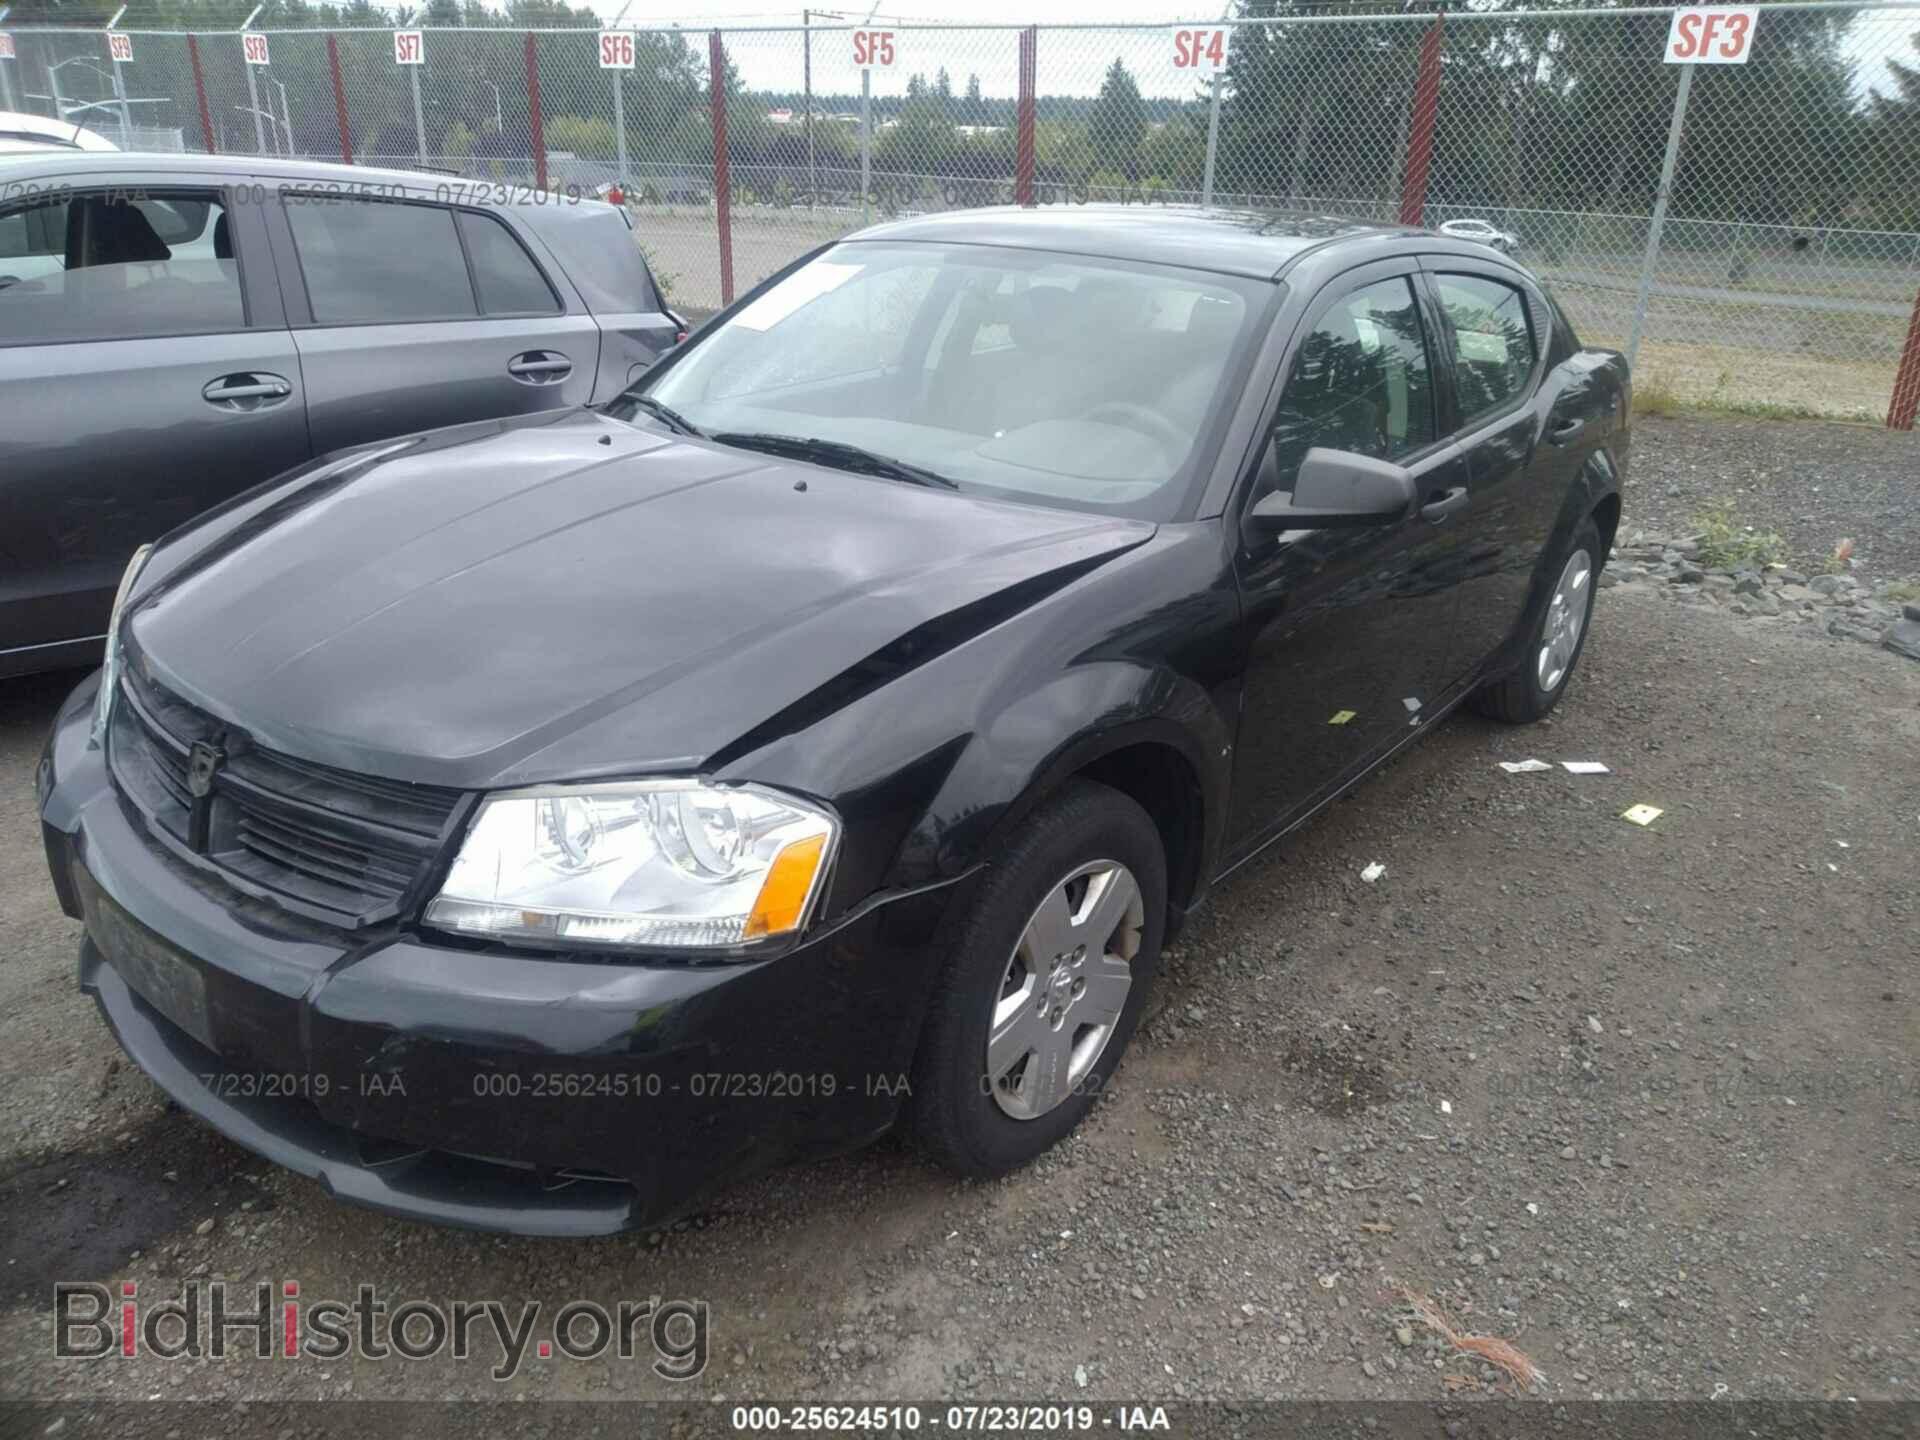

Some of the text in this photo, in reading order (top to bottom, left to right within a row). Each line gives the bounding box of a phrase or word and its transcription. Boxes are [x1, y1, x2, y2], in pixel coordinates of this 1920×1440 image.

[111, 36, 131, 58] SF9
[245, 36, 268, 60] SF8
[397, 35, 420, 60] SF7
[602, 35, 631, 65] SF6
[853, 31, 895, 65] SF5
[1174, 31, 1223, 67] SF4
[1673, 13, 1750, 58] SF3
